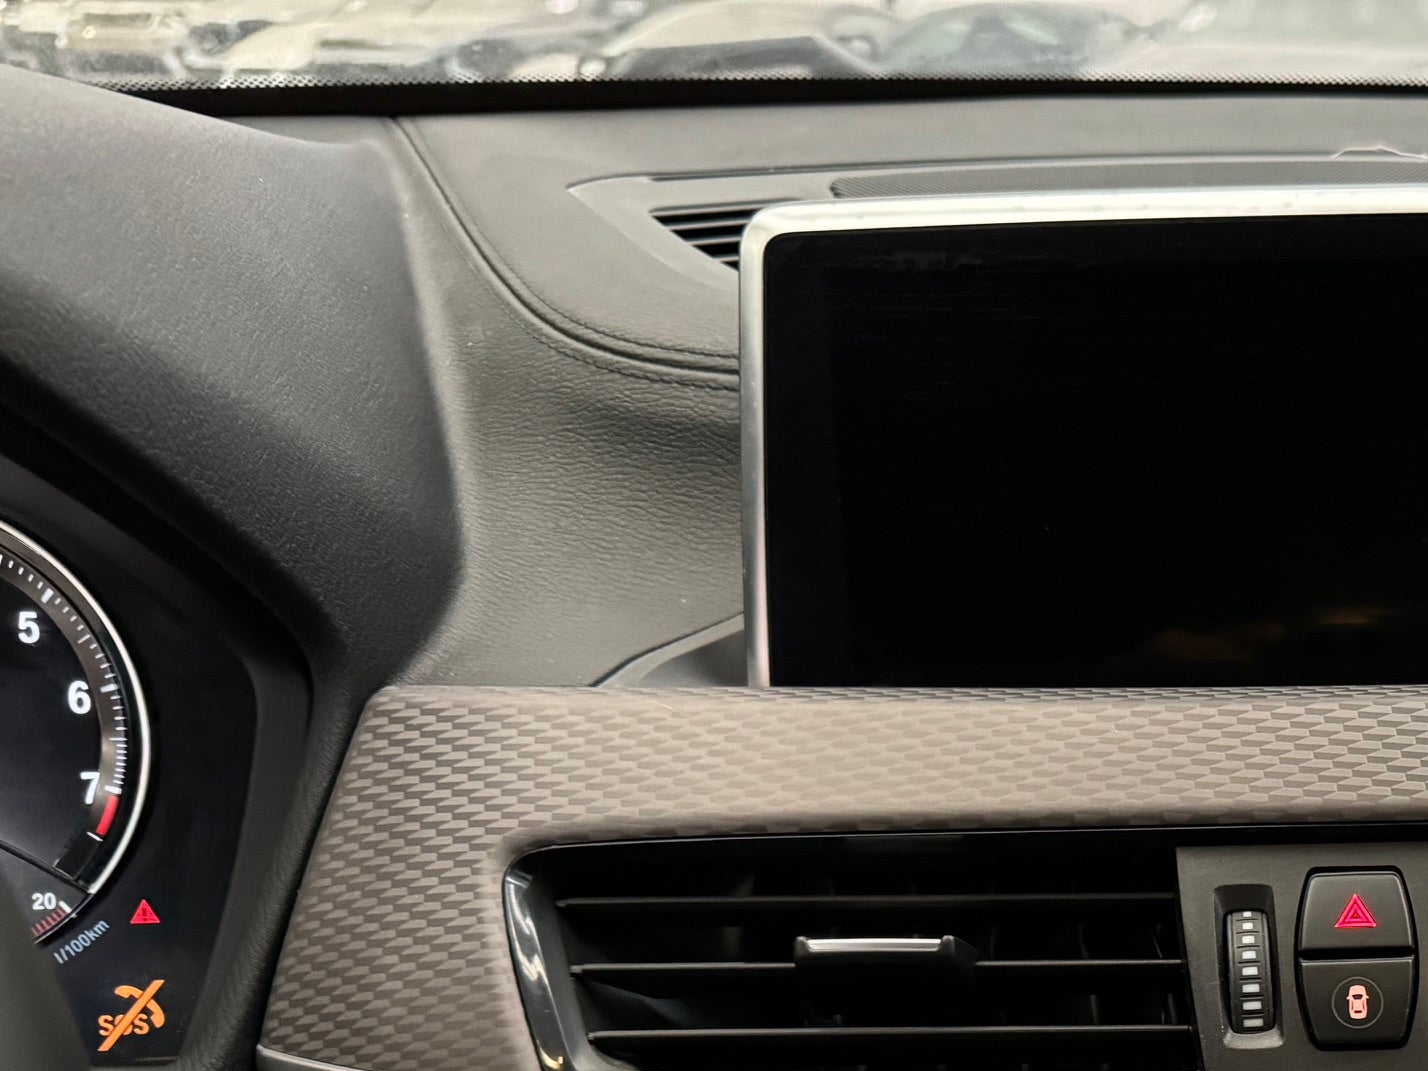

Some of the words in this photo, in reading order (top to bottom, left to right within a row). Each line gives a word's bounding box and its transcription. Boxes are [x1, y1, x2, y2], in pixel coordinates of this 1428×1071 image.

[18, 611, 41, 644] 5
[67, 680, 92, 714] 6
[80, 771, 101, 804] 7
[32, 892, 57, 911] 20
